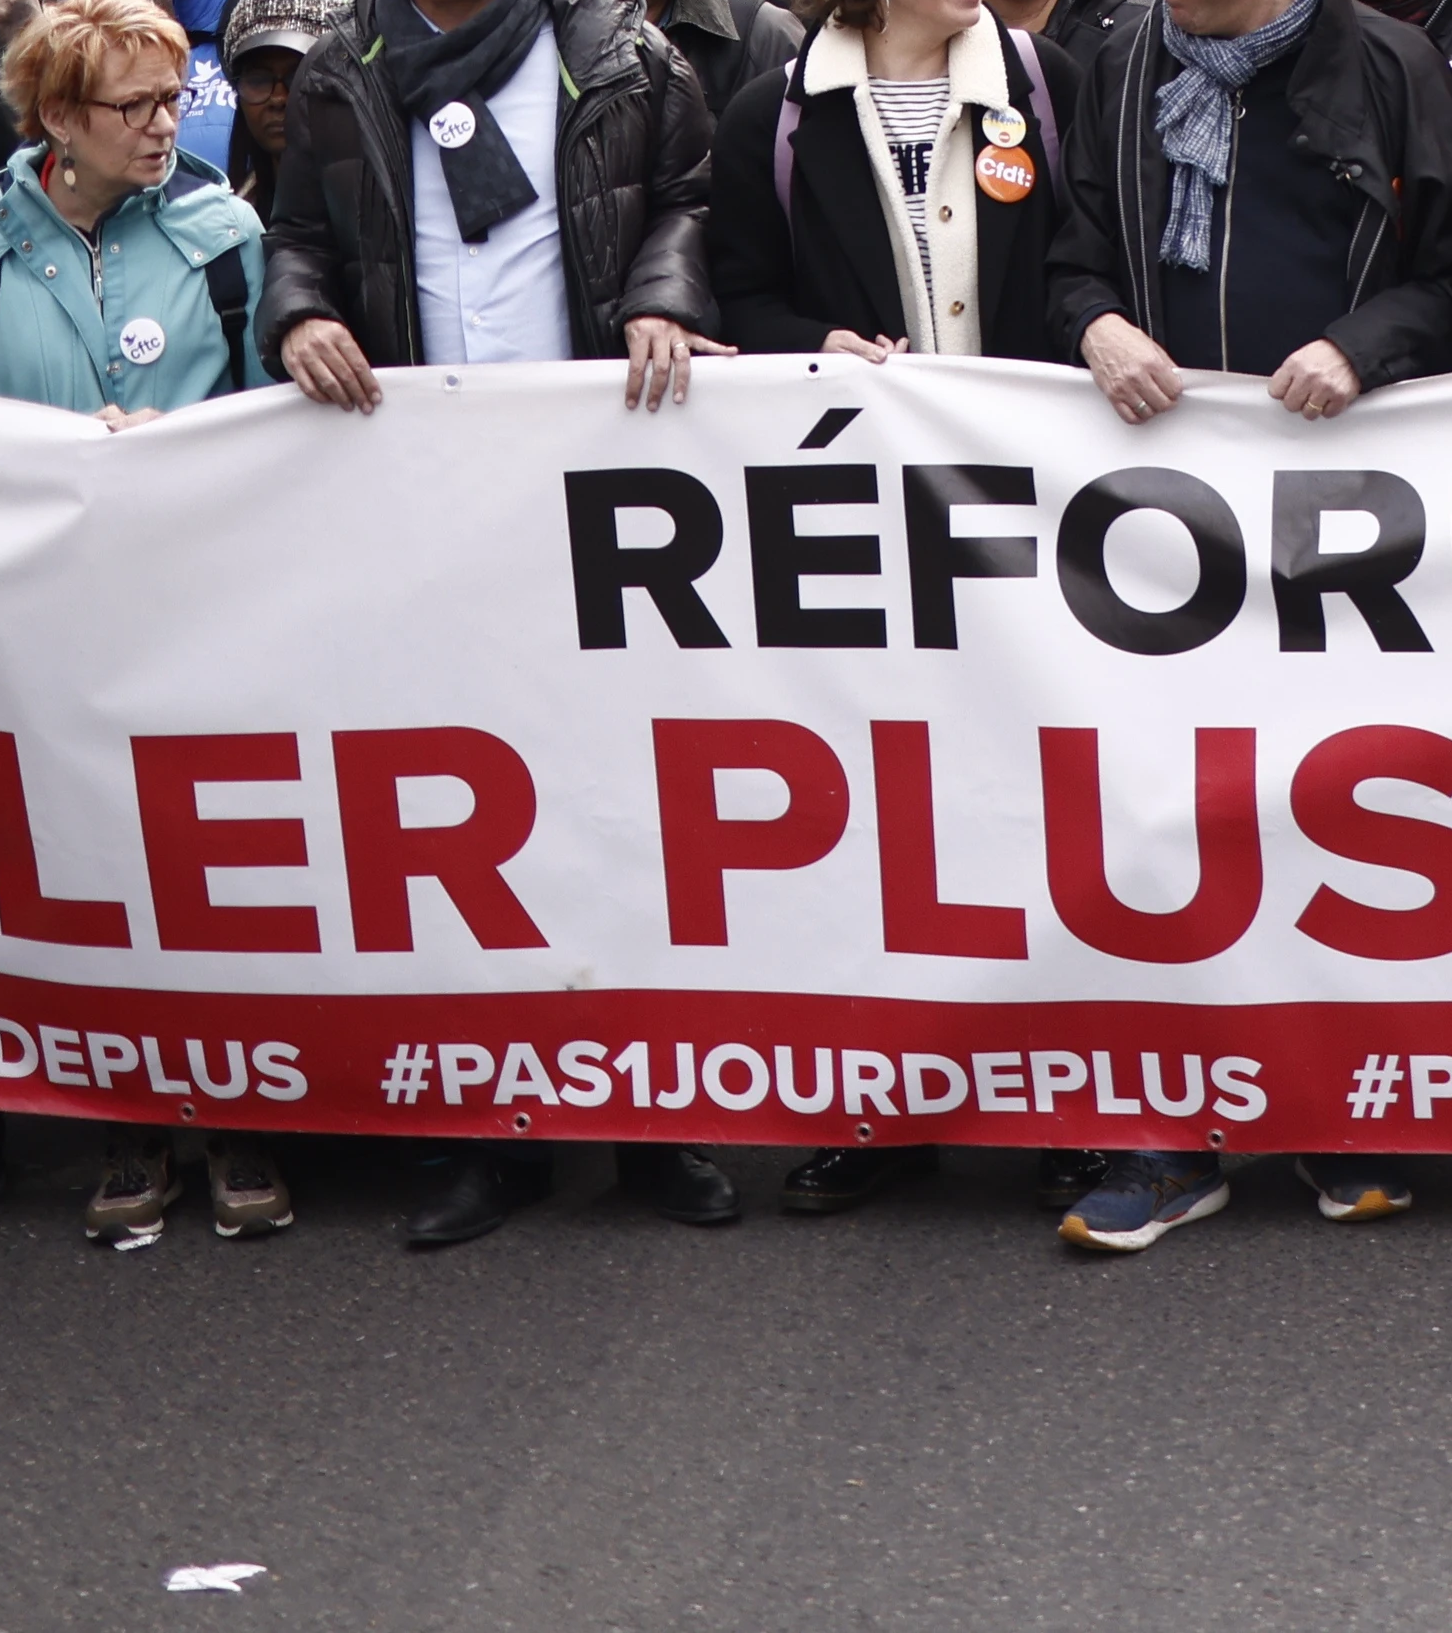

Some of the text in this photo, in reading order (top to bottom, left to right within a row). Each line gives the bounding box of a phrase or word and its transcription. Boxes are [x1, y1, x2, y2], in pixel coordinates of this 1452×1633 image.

[439, 119, 472, 145] cftc
[128, 335, 163, 362] cftc
[380, 1039, 1268, 1122] #PAS1JOURDEPLUS
